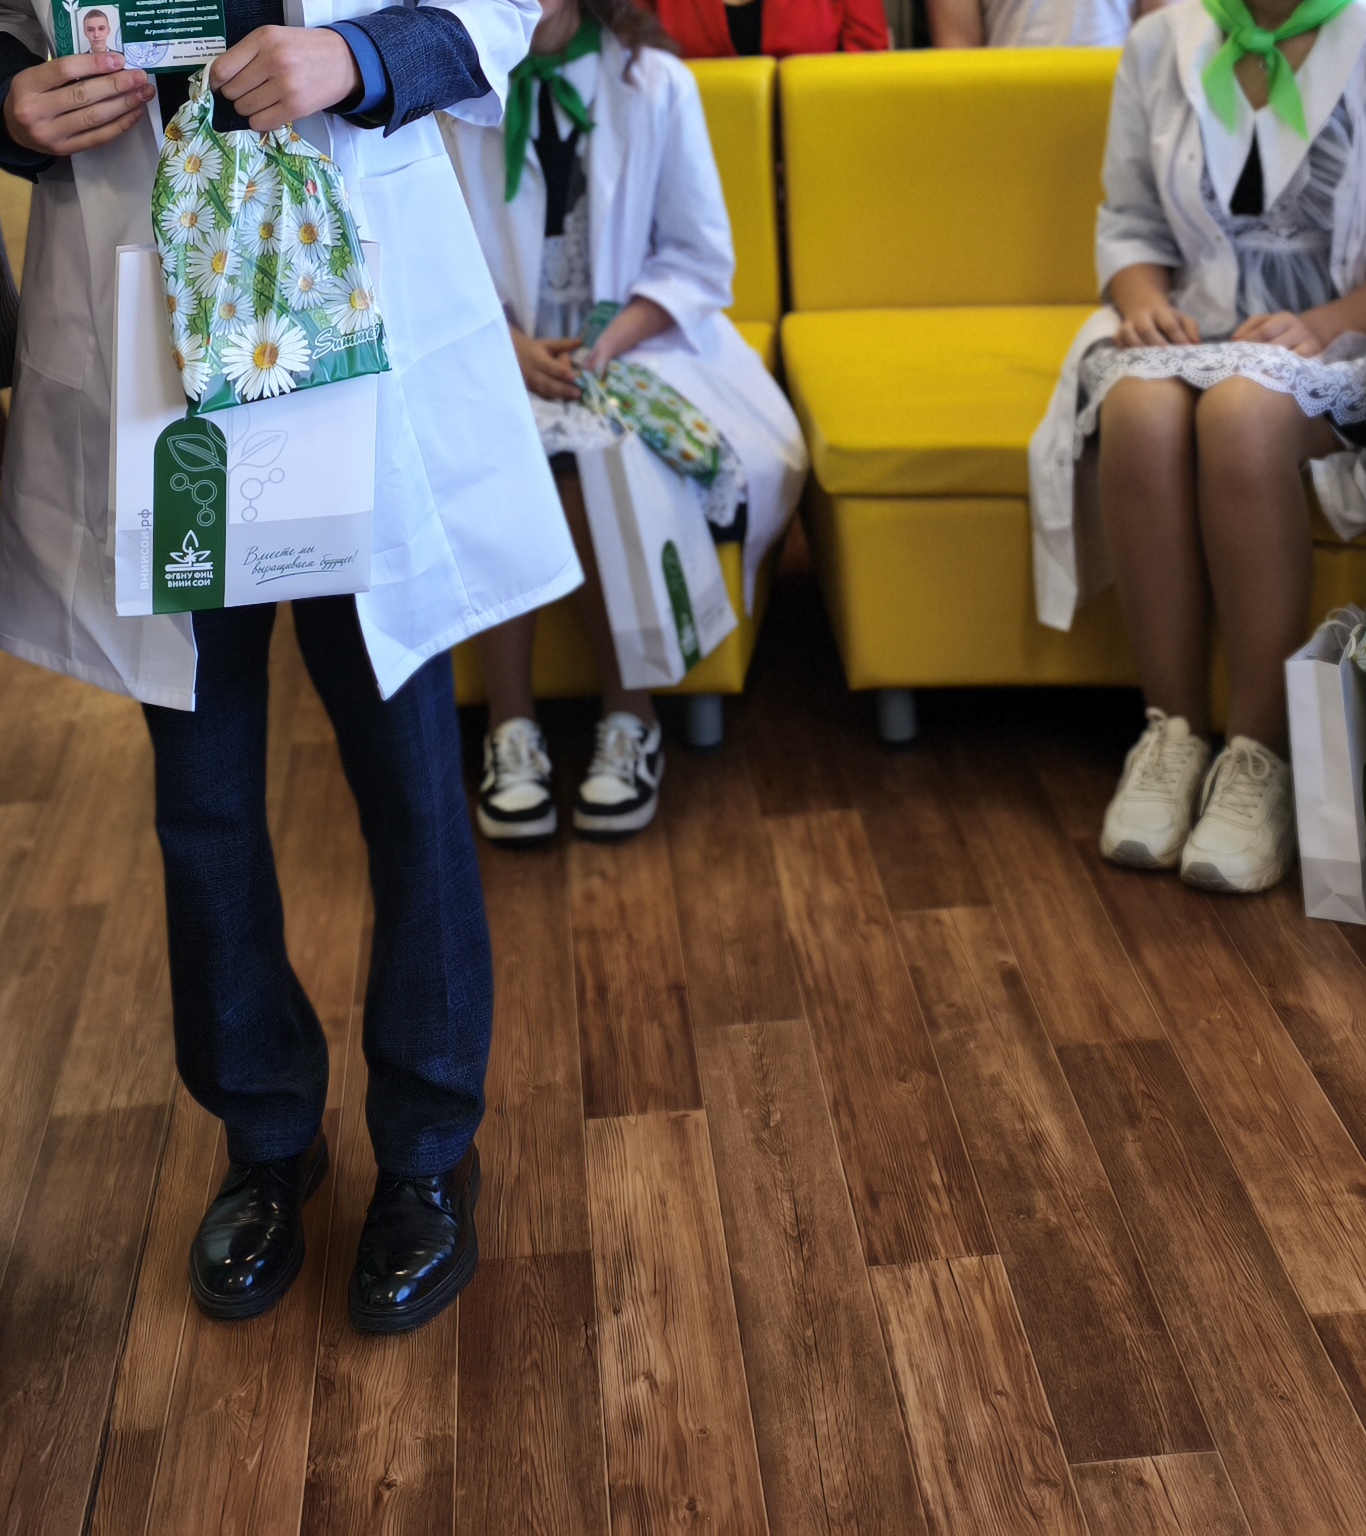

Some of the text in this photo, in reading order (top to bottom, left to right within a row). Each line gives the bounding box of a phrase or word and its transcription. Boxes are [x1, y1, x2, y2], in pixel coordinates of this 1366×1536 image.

[312, 324, 381, 360] Summer
[243, 545, 315, 566] Вместе мы
[164, 570, 214, 580] ФГБНУ ФНЦ
[251, 556, 316, 579] выращиваем
[167, 578, 211, 588] ВНИИ СОИ
